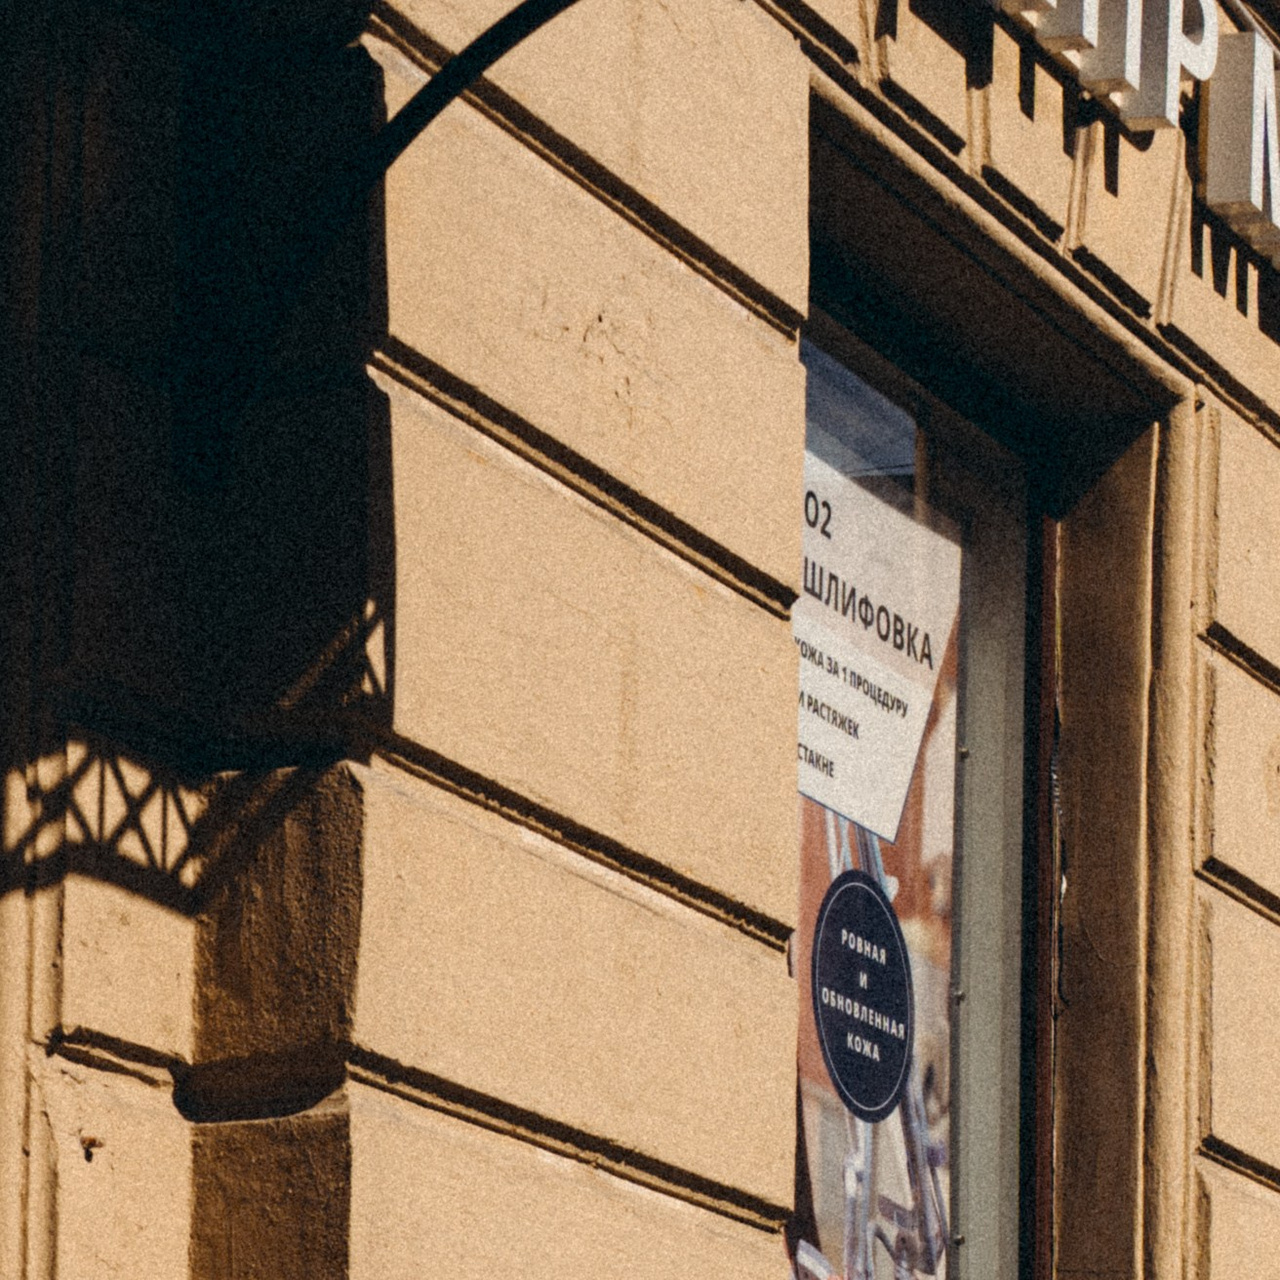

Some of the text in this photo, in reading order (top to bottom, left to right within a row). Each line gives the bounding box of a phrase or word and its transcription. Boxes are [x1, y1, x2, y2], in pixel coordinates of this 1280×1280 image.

[803, 556, 934, 671] ШЛИФОВКА
[827, 656, 840, 679] ЗА
[849, 671, 909, 719] ПРОЦЕДУРУ
[806, 694, 861, 740] РАСТЯЖЕК
[841, 929, 887, 965] РОВНАЯ
[859, 971, 868, 990] И
[821, 987, 905, 1041] ОБНОВЛЕННАЯ
[847, 1032, 880, 1063] КОЖА
